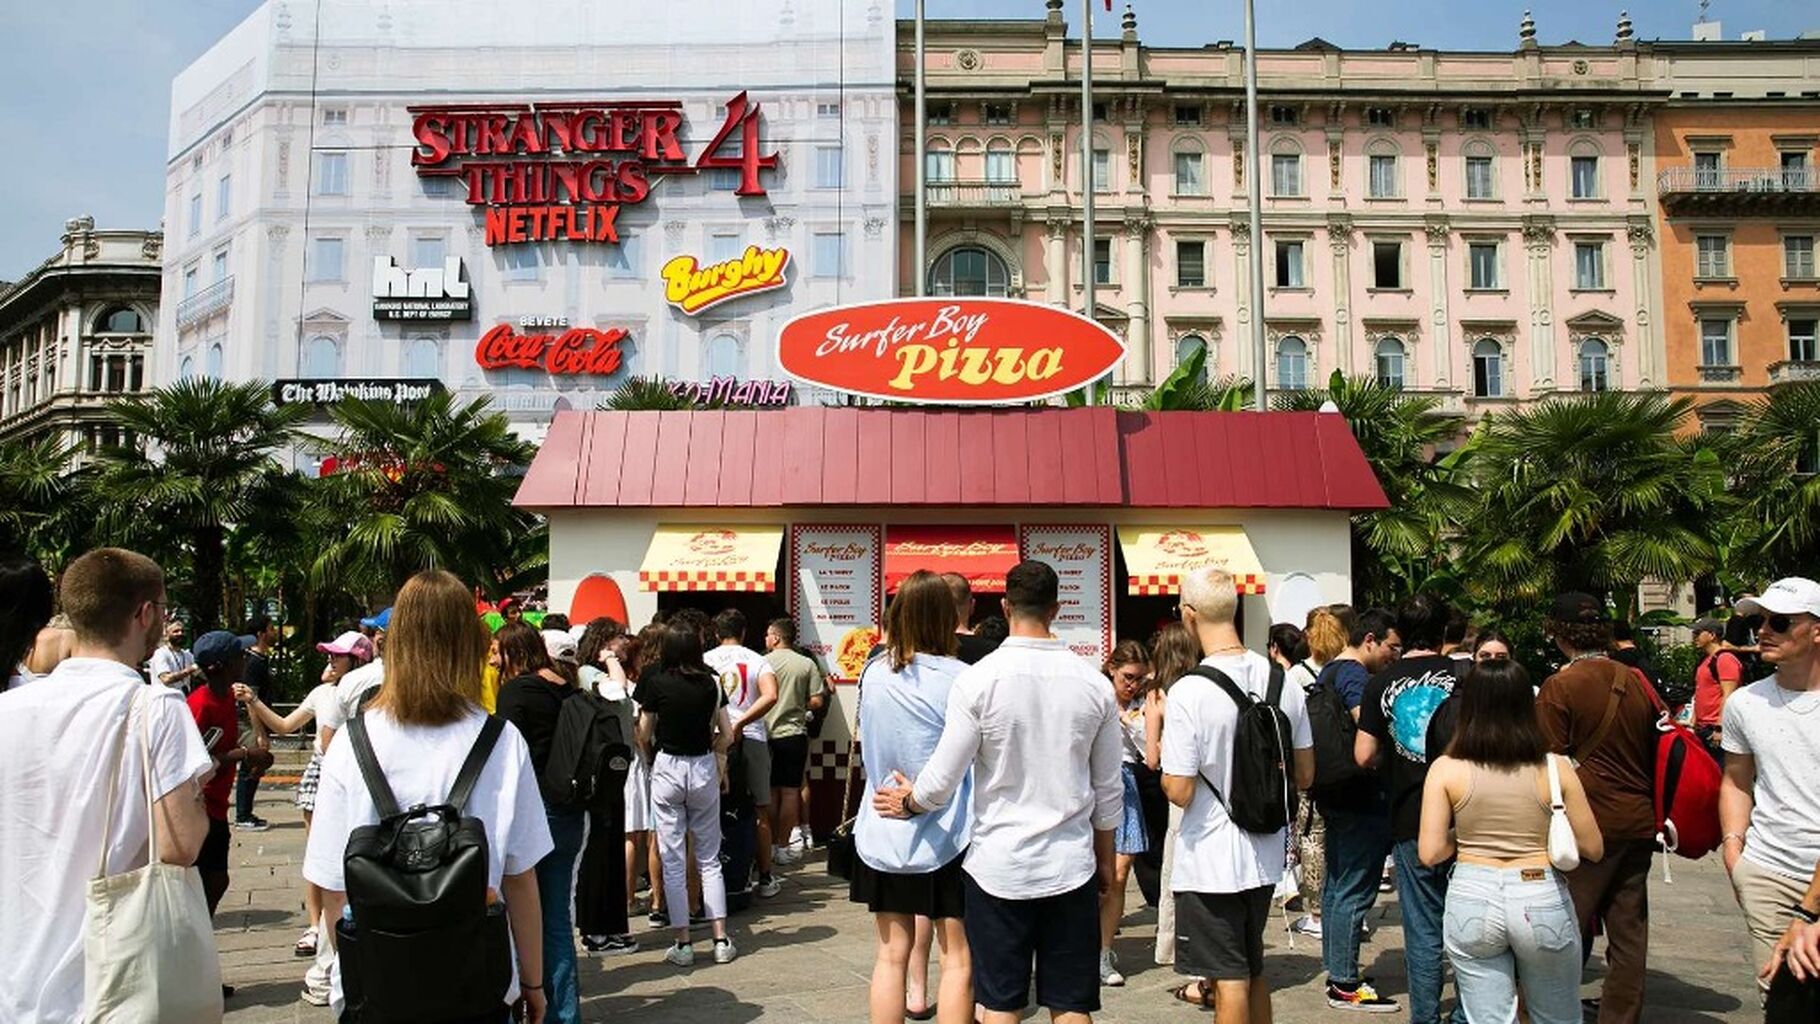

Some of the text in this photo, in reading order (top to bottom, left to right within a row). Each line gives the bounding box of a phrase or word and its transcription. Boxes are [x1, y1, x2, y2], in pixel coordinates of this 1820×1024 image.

[411, 90, 781, 197] STRANGER 4
[460, 161, 652, 206] THINGS
[486, 204, 621, 248] NETFLIX
[661, 245, 789, 304] Burghy
[475, 323, 629, 376] Coca-Cola
[815, 305, 988, 358] Surfer Boy
[281, 383, 314, 403] The
[394, 381, 431, 405] Post
